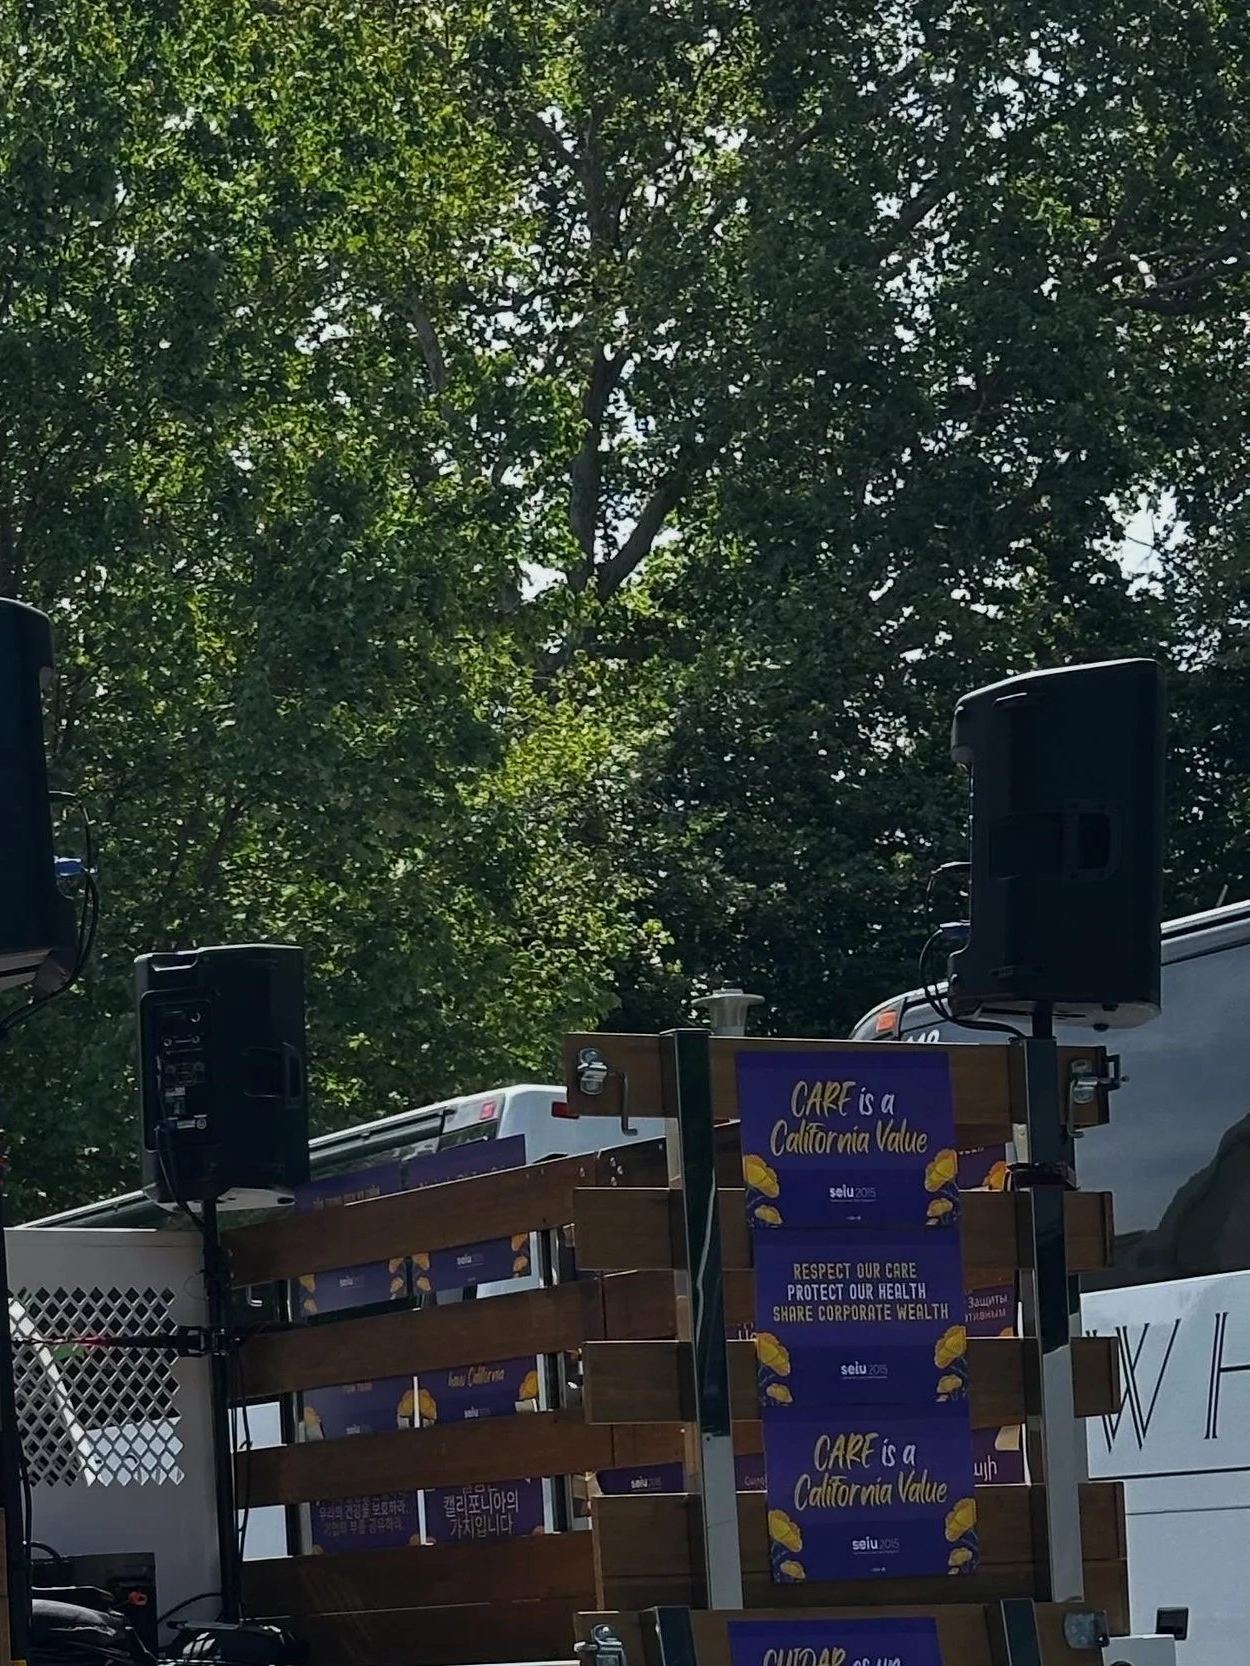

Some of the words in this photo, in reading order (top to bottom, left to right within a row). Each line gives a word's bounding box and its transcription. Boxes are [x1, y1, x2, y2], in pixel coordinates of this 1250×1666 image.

[791, 1079, 855, 1117] CARE
[859, 1086, 873, 1116] is
[881, 1092, 895, 1115] a
[770, 1119, 869, 1156] California
[876, 1118, 928, 1153] Value
[855, 1187, 876, 1198] 2015
[794, 1262, 850, 1280] RESPECT
[856, 1262, 880, 1279] OUR
[886, 1262, 917, 1278] CARE
[788, 1284, 844, 1300] PROTECT
[850, 1283, 874, 1299] OUR
[879, 1282, 926, 1299] HEALTH
[773, 1305, 813, 1322] SHARE
[818, 1304, 891, 1321] CORPORATE
[896, 1303, 949, 1320] WEALTH
[841, 1360, 867, 1375] seiu
[814, 1432, 879, 1471] CARE
[881, 1438, 896, 1467] is
[902, 1444, 916, 1466] a
[794, 1473, 893, 1511] California
[898, 1469, 948, 1504] Value
[443, 1488, 519, 1518] 캘리포니아의
[450, 1512, 514, 1540] 가치입니다
[852, 1536, 879, 1551] seiu
